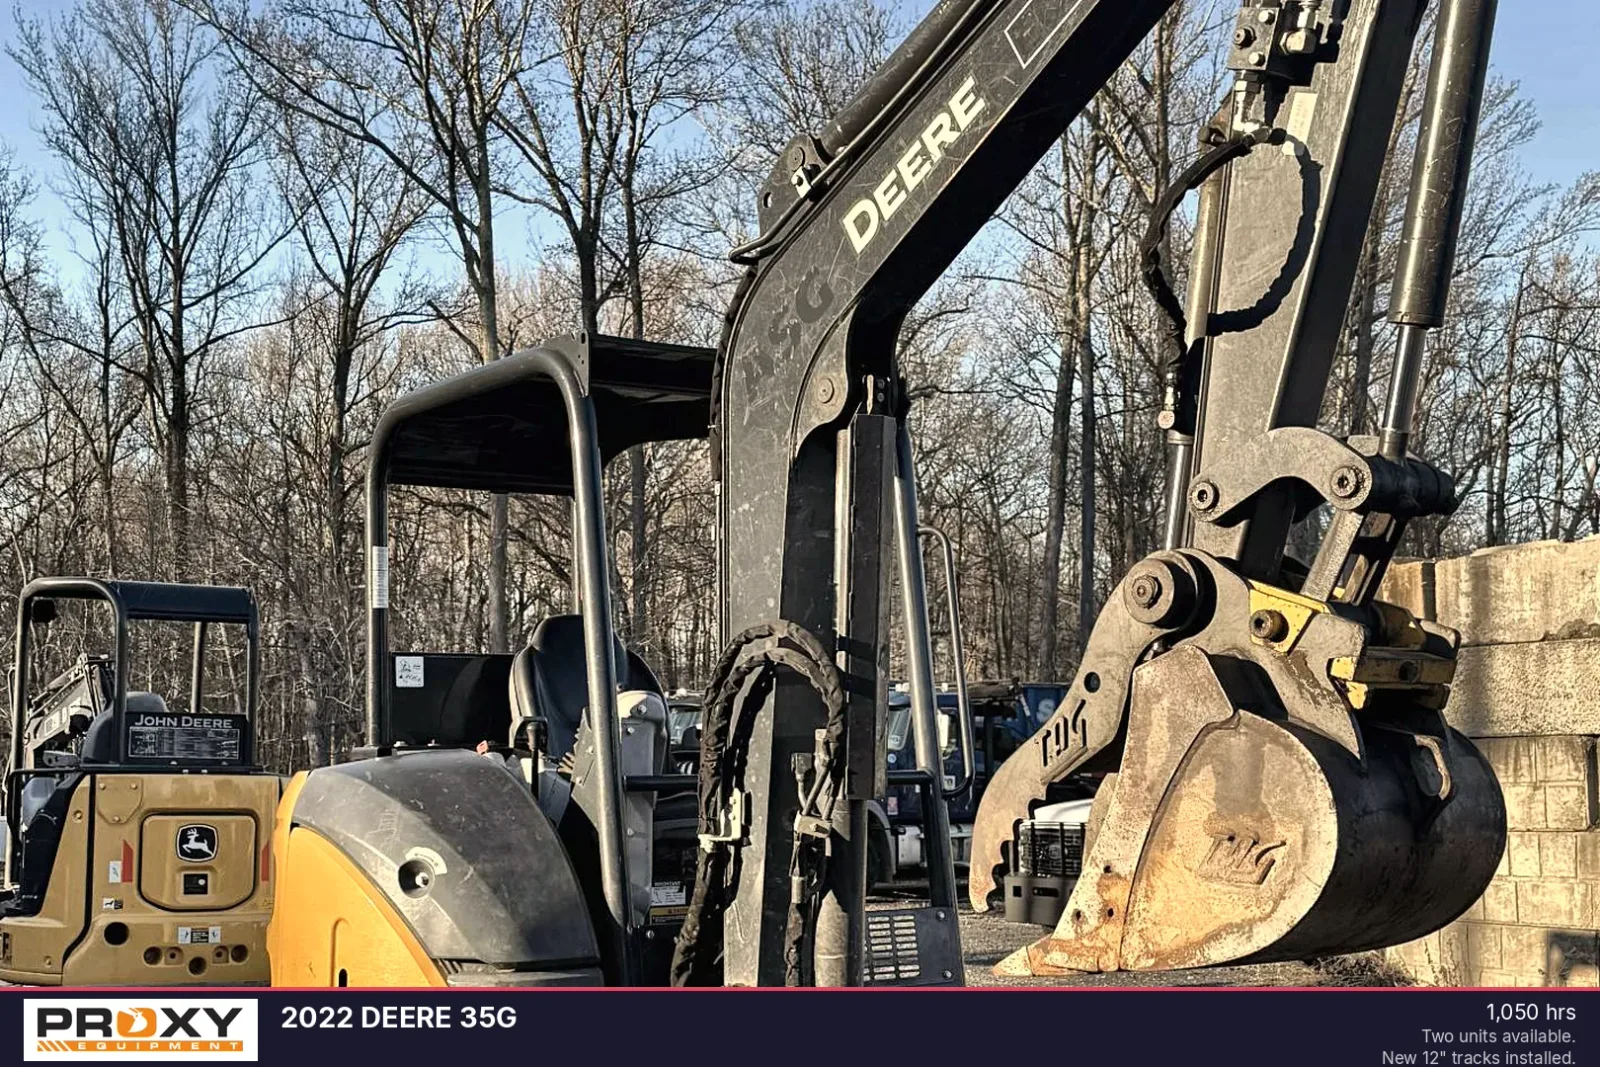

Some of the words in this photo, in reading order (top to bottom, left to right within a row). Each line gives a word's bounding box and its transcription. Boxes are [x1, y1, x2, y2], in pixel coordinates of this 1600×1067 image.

[842, 75, 985, 254] DEERE
[135, 714, 178, 727] JOHN
[181, 716, 233, 729] DEERE
